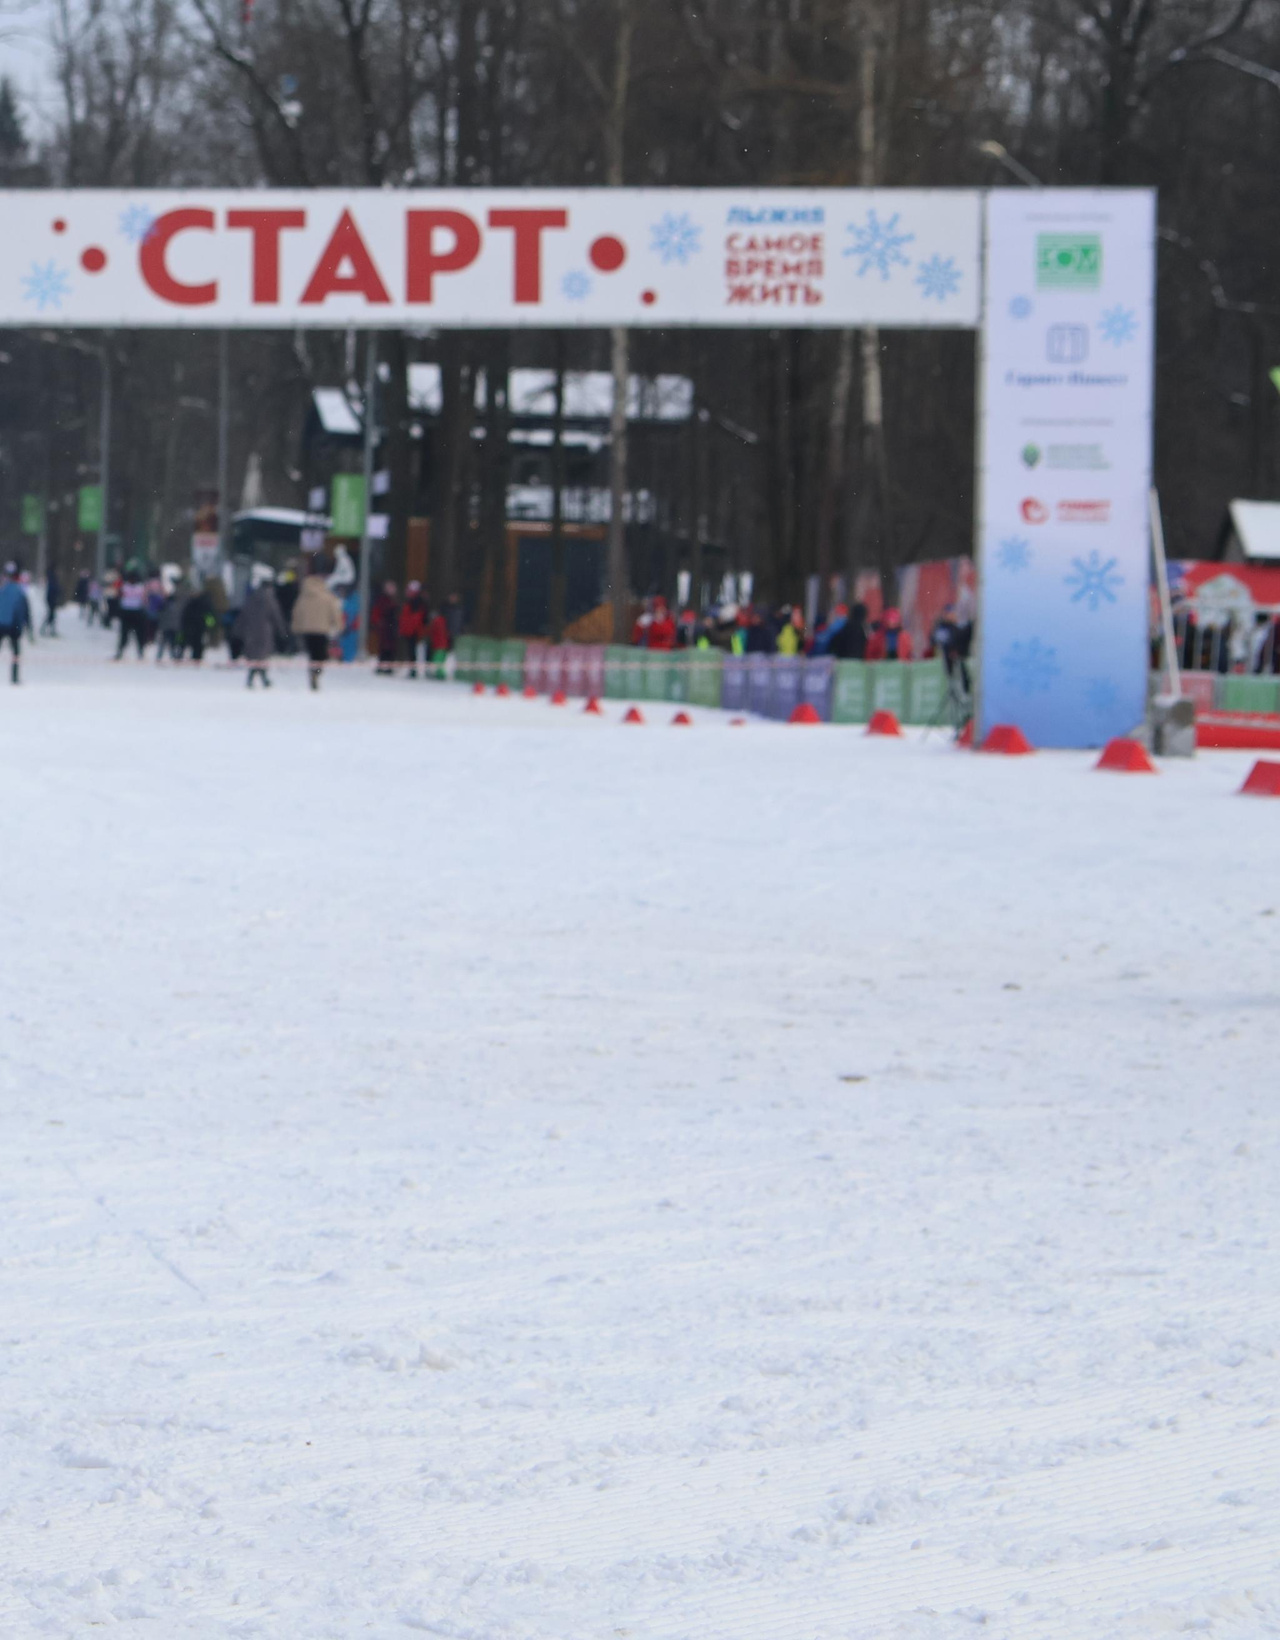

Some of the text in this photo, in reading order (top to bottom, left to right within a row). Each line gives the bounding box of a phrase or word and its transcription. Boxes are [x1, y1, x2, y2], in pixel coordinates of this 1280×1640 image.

[727, 206, 824, 224] ЛЫЖНЯ
[726, 233, 823, 254] САМОЕ
[138, 206, 569, 306] СТАРТ
[726, 258, 823, 278] ВРЕМЯ
[726, 283, 824, 305] ЖИТЬ
